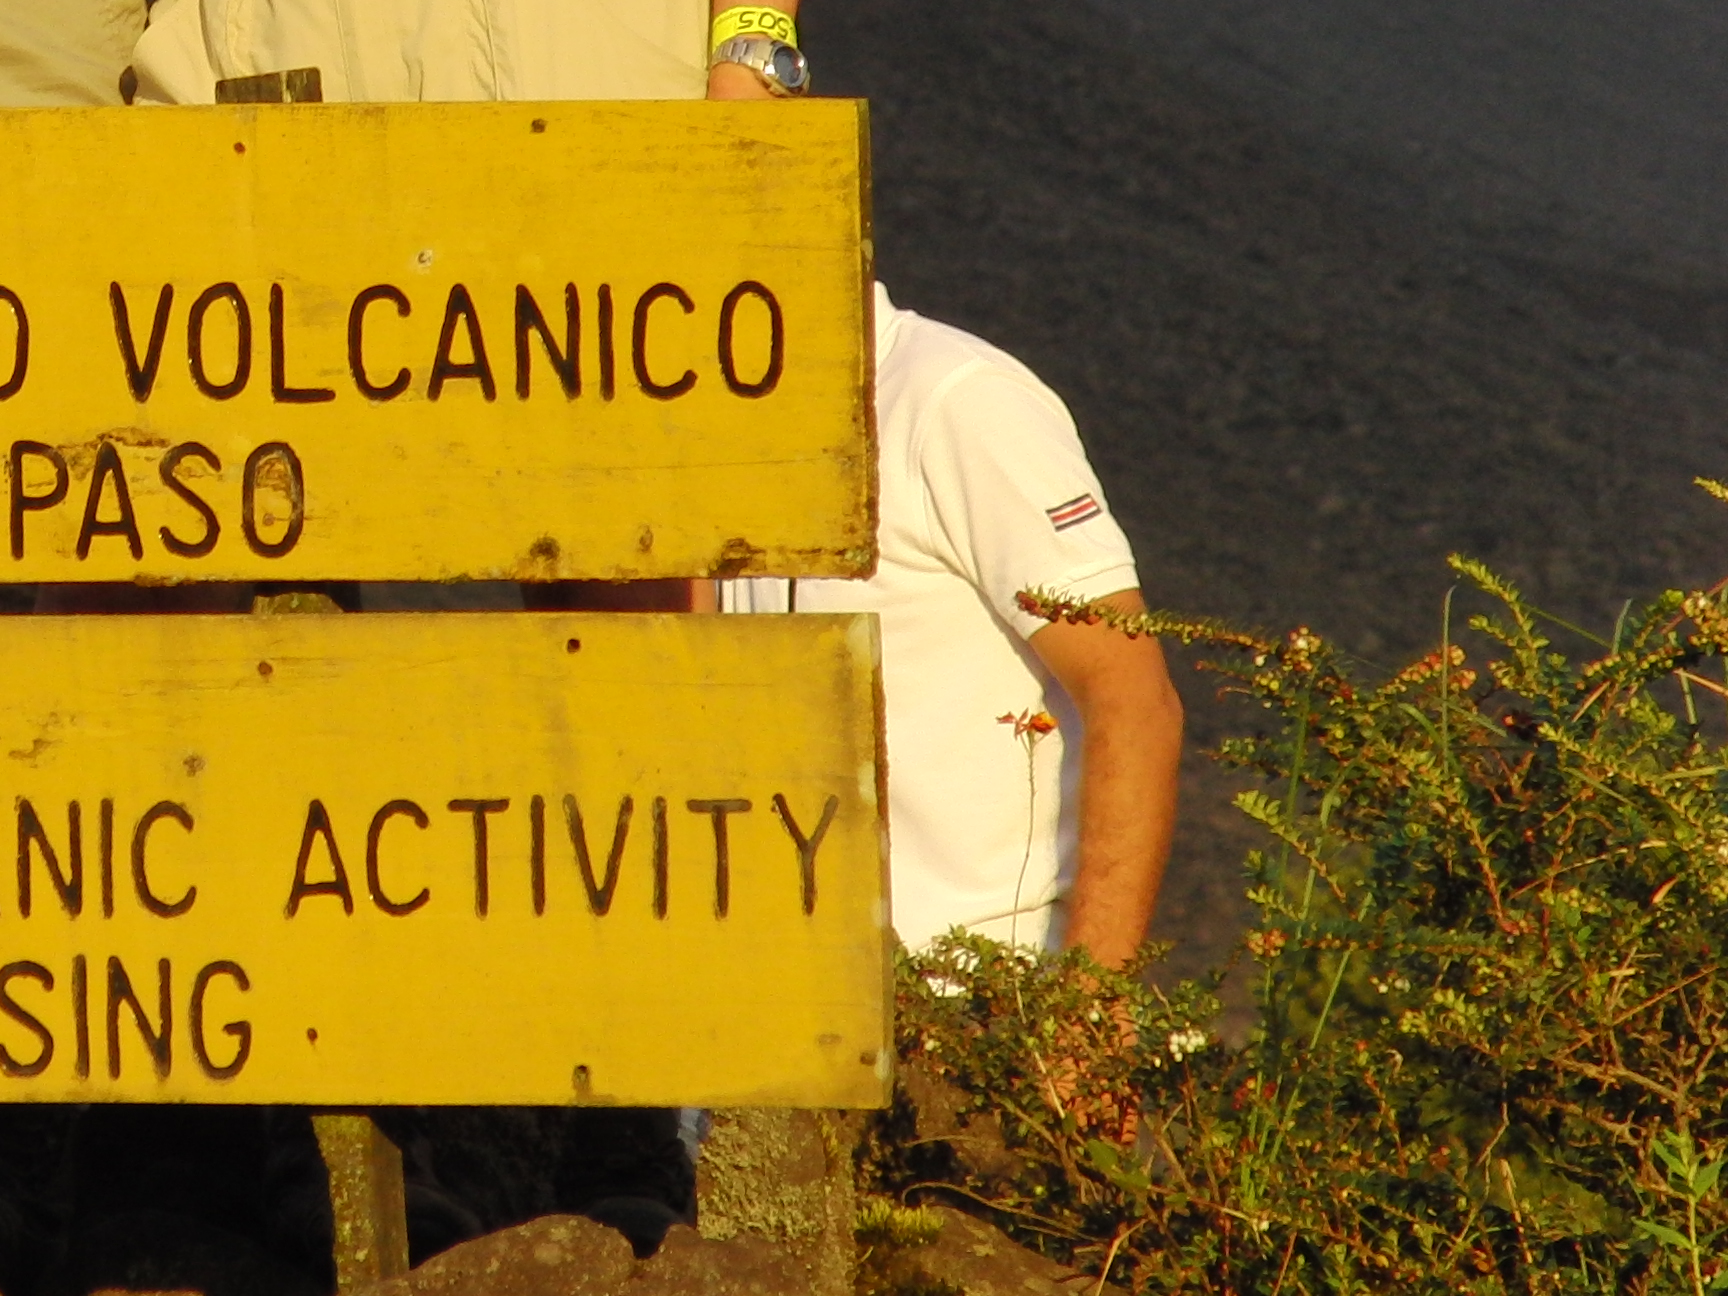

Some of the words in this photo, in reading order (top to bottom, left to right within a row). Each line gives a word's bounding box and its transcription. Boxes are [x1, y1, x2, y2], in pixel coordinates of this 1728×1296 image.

[108, 280, 785, 404] VOLCANICO
[8, 440, 306, 560] PASO
[284, 793, 840, 918] ACTIVITY
